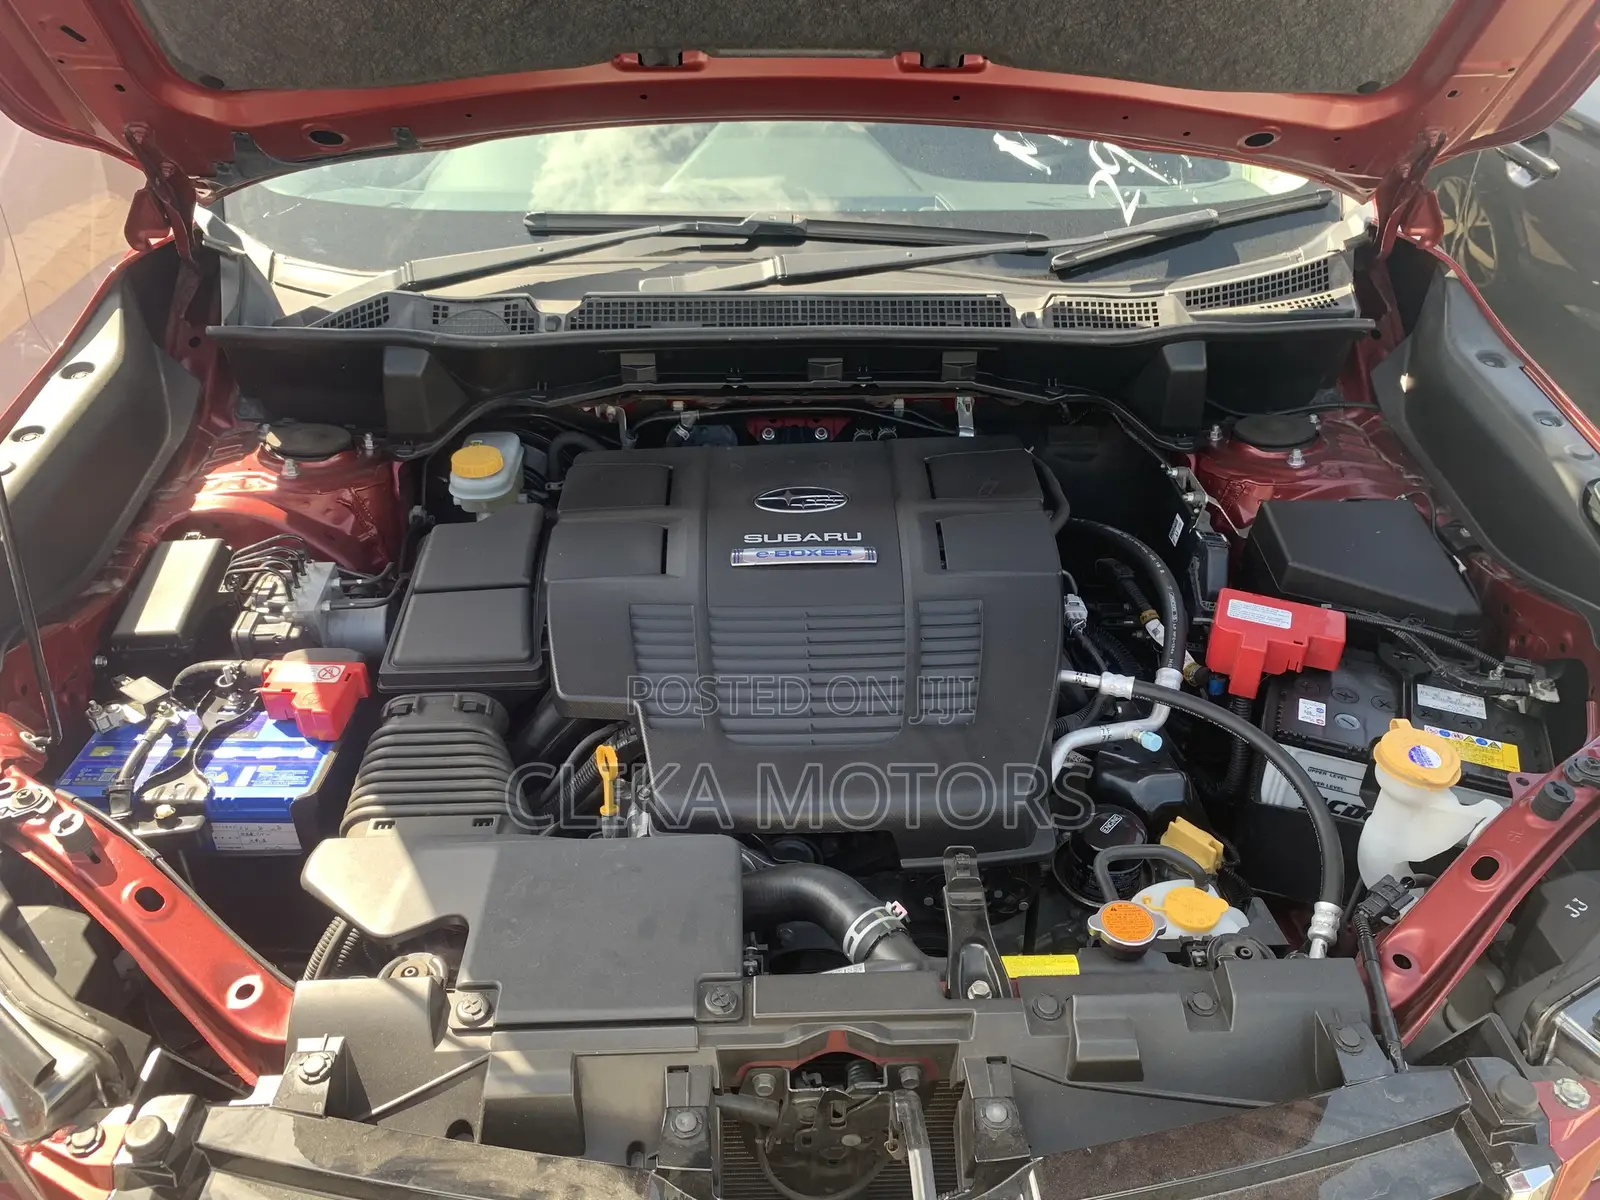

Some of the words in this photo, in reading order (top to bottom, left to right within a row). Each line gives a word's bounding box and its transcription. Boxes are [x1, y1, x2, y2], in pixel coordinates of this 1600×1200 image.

[743, 532, 862, 544] SUBARU
[755, 548, 853, 559] e-BOXER
[1307, 766, 1327, 776] UPPER
[1329, 772, 1348, 781] LEVEL
[1325, 783, 1344, 791] LEVEL
